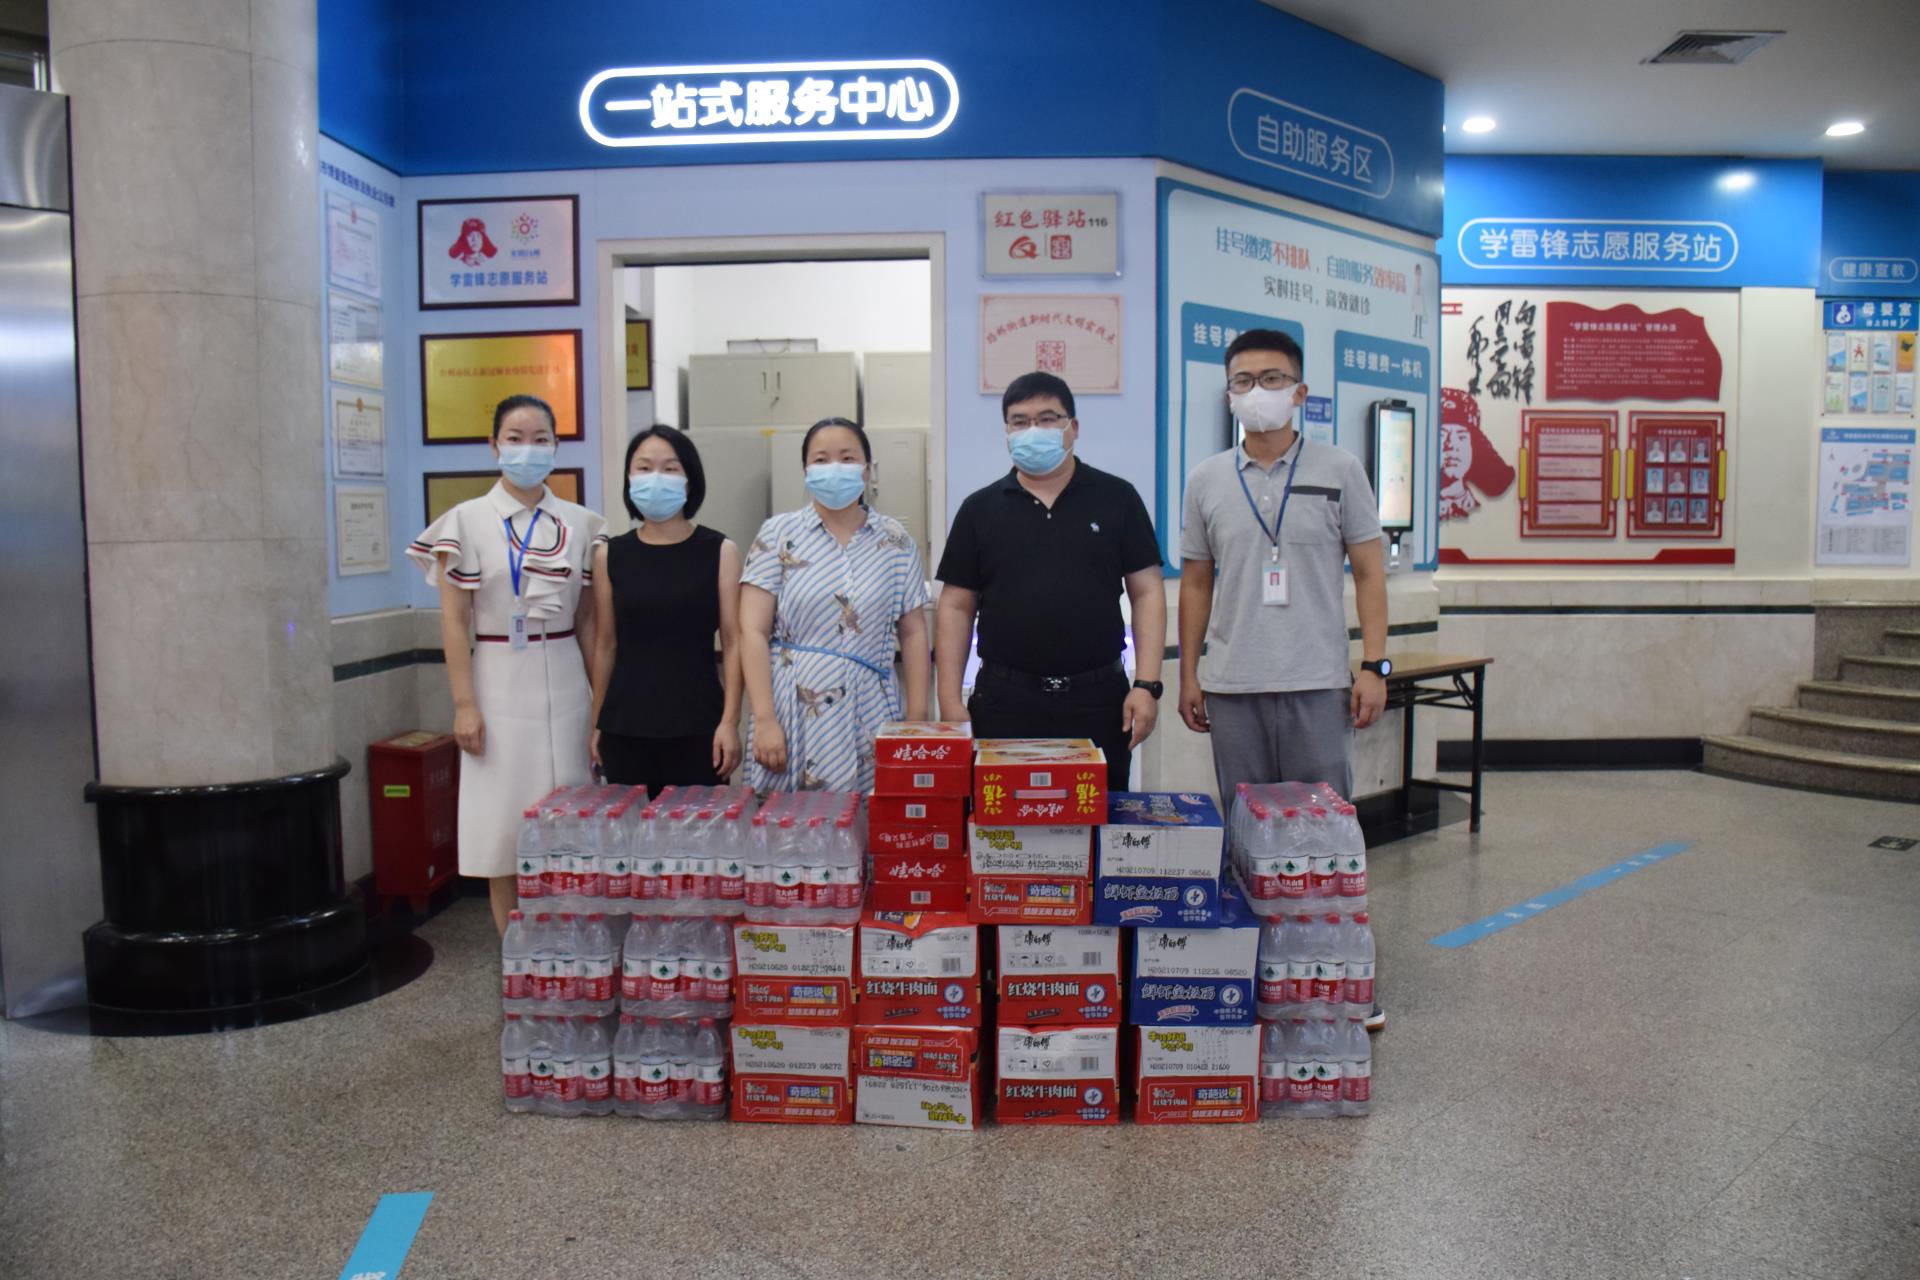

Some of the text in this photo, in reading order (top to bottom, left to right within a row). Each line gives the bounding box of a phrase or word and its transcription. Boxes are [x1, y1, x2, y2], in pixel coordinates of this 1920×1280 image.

[604, 75, 934, 129] 一站式服务中心
[1256, 114, 1374, 185] 自助服务区
[994, 209, 1108, 229] 红色驿站 116
[1479, 227, 1722, 263] 学雷锋志愿服务站
[450, 270, 548, 287] 学雷锋志愿服务站
[1842, 262, 1905, 278] 健康宣教
[1862, 302, 1912, 317] 母婴室
[1344, 348, 1423, 379] 挂号缴费一体机
[893, 744, 948, 761] 娃哈哈
[889, 861, 944, 878] 娃哈哈
[1104, 883, 1179, 901] 鲜虾鱼板面
[866, 981, 938, 996] 红烧牛肉面
[1008, 981, 1080, 996] 红烧牛肉面
[1141, 983, 1216, 1000] 鲜虾鱼板面
[1006, 1084, 1077, 1098] 红烧牛肉面
